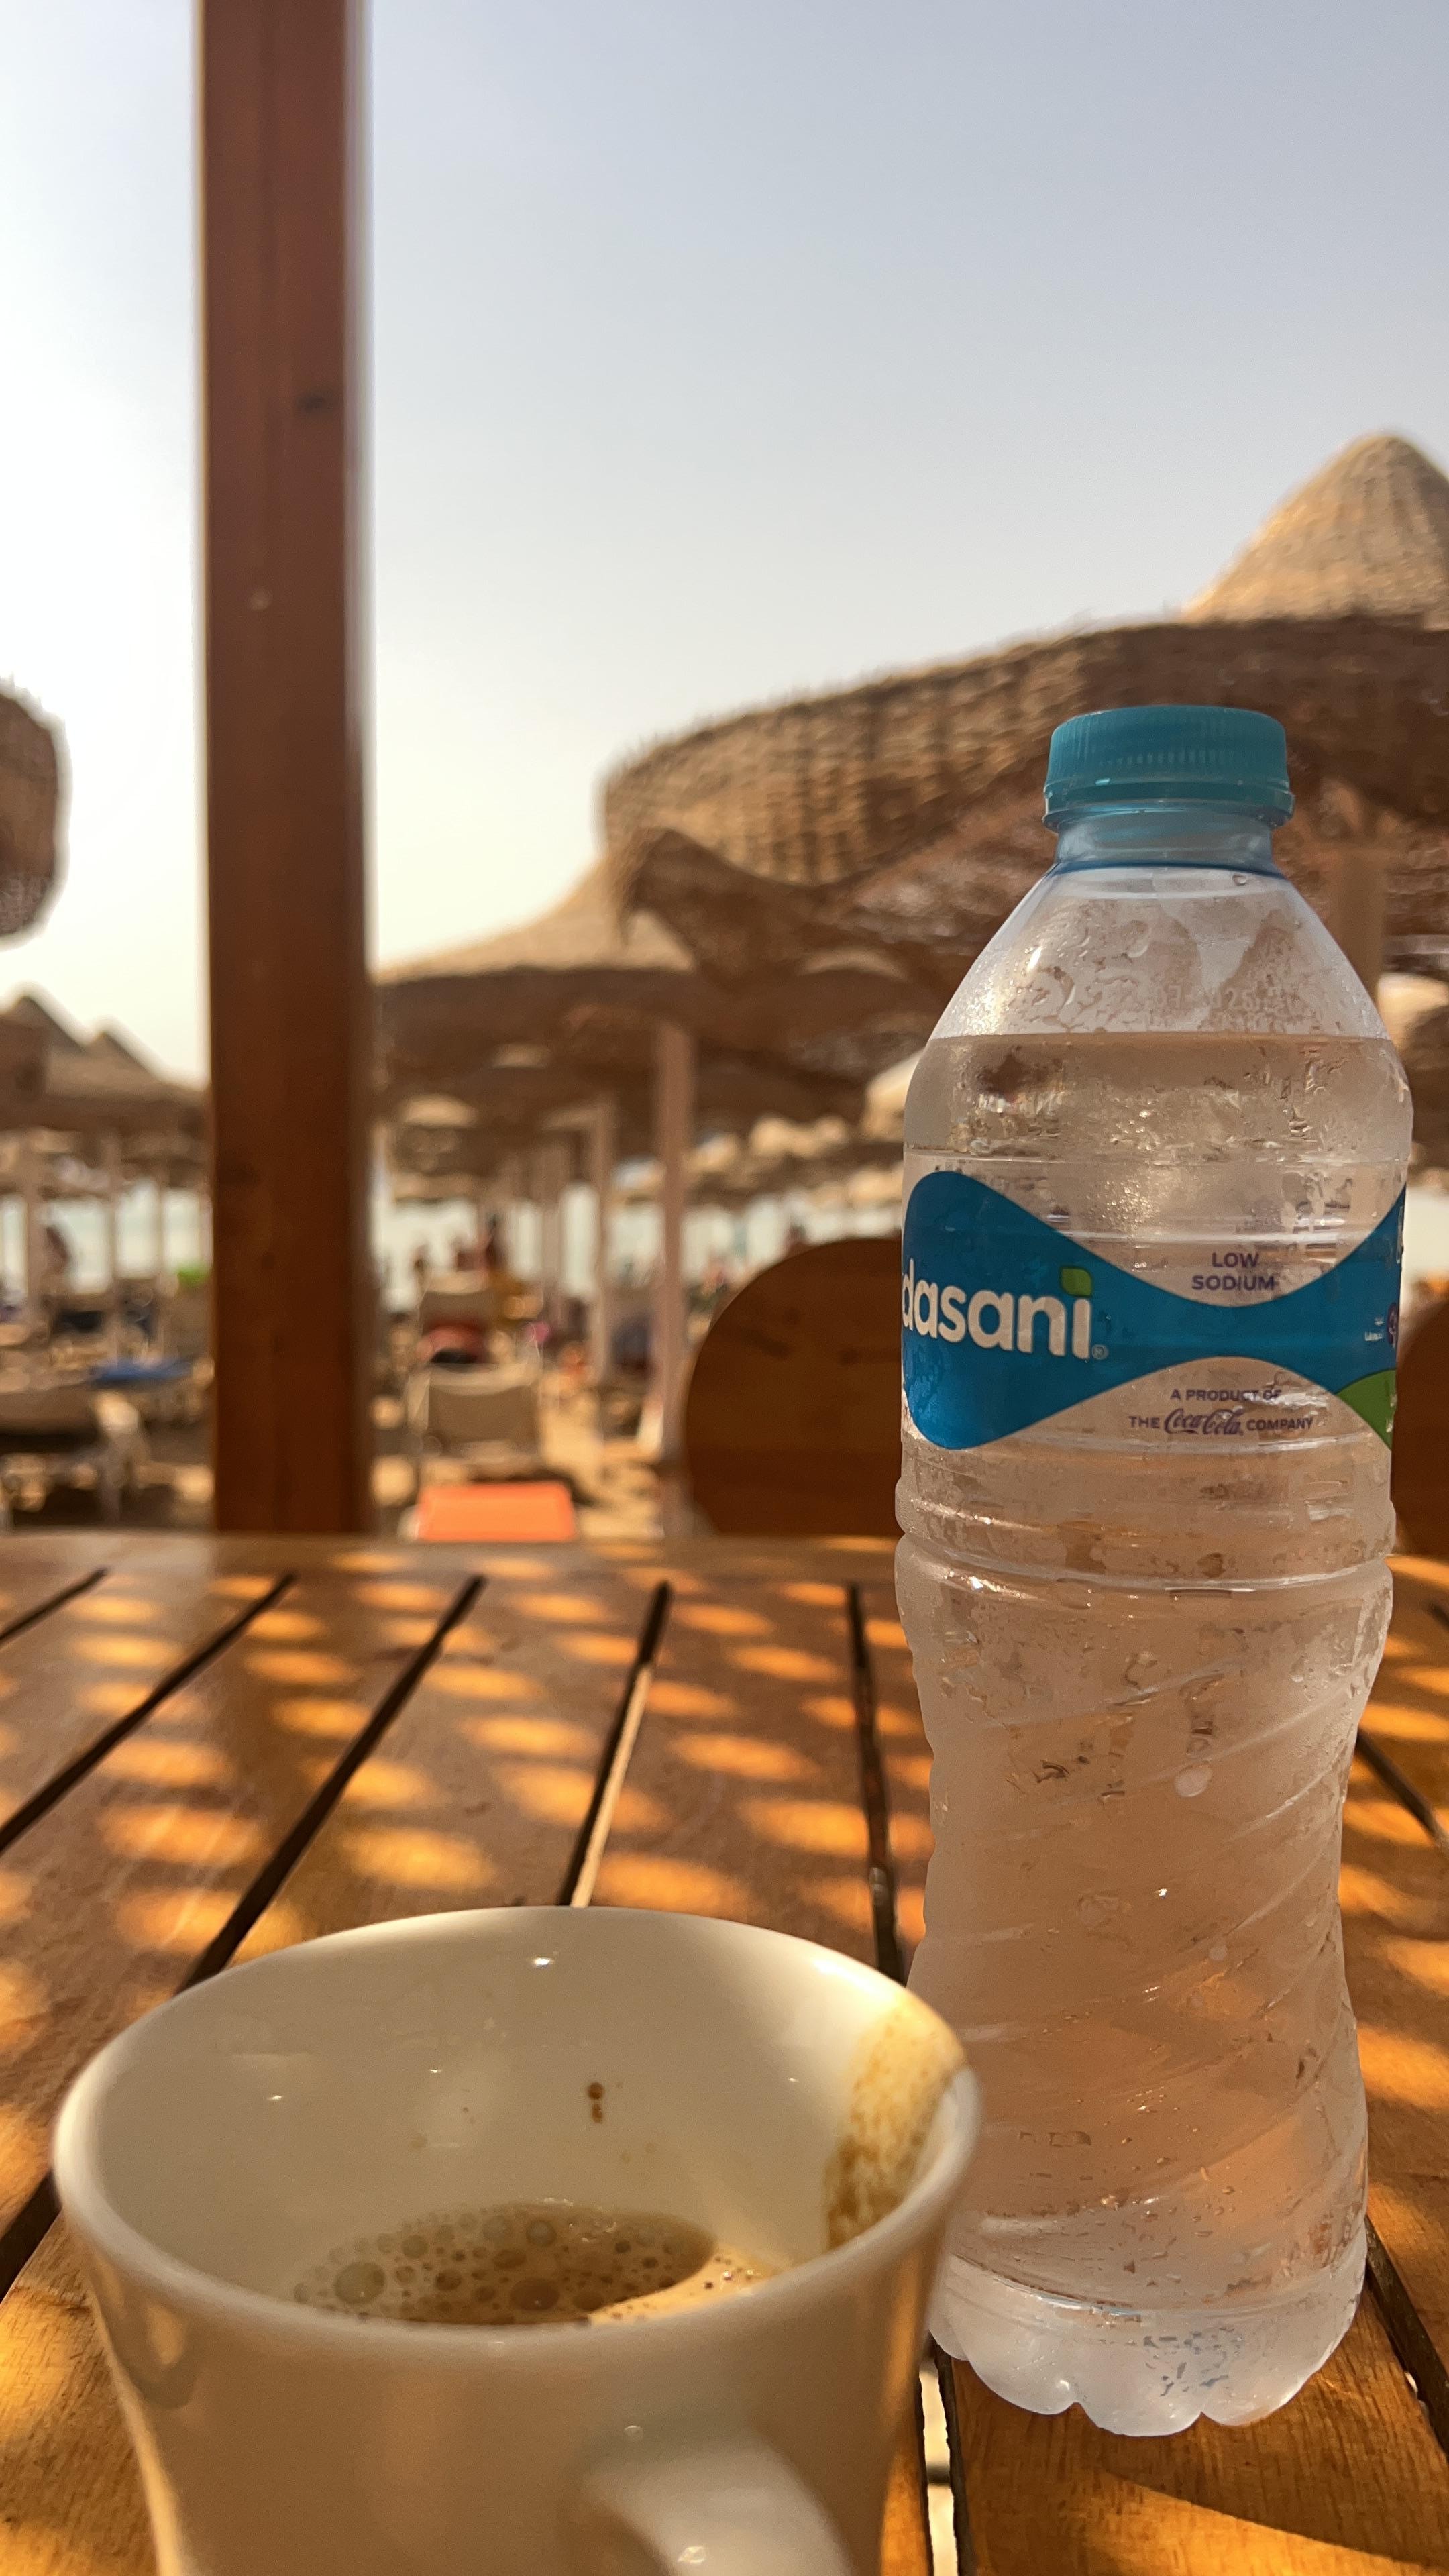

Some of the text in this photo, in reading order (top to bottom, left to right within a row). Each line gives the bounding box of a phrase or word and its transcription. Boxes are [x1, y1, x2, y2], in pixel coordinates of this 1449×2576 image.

[1212, 1252, 1259, 1267] LOW
[1191, 1275, 1274, 1291] SODIUM
[902, 1257, 1092, 1360] dasani
[1170, 1389, 1282, 1401] A PRODUCT OF
[1128, 1415, 1160, 1429] THE
[1246, 1417, 1313, 1431] COMPANY
